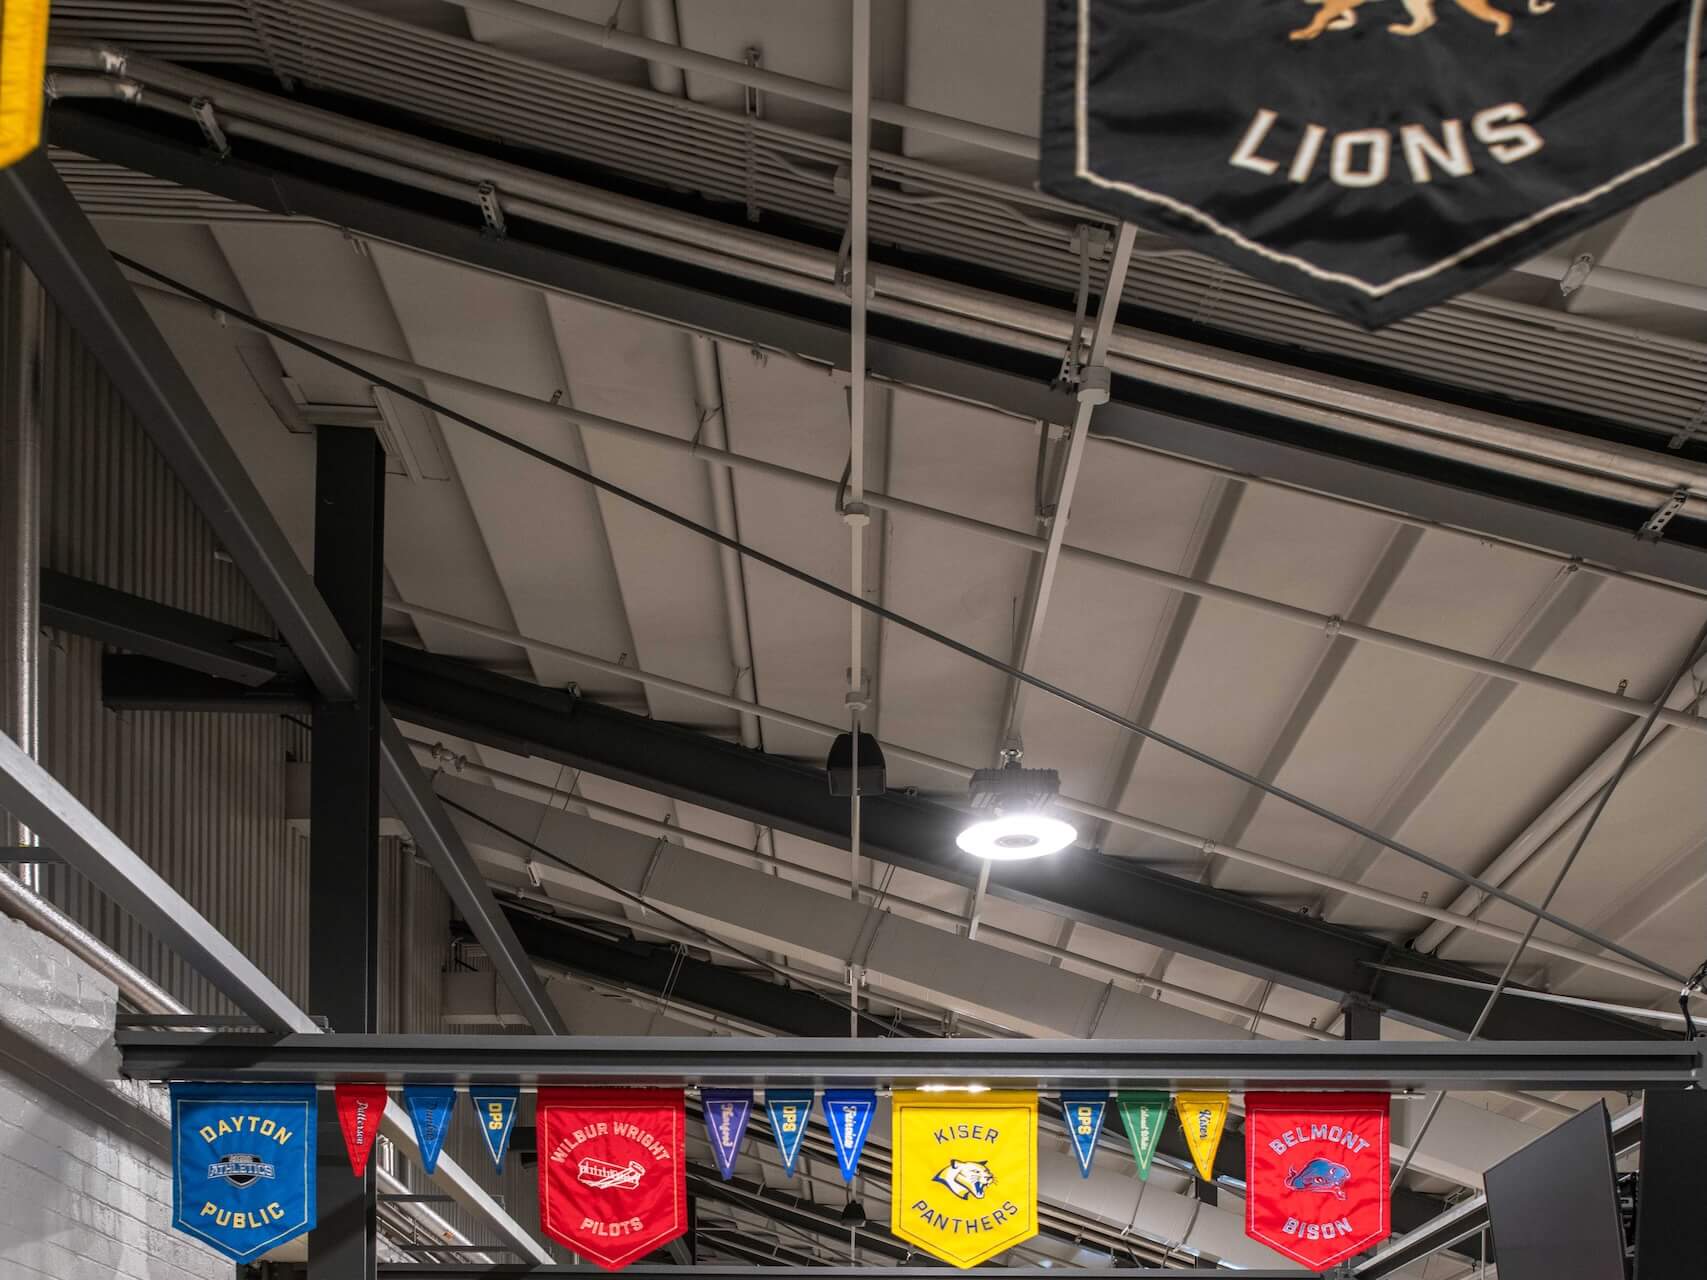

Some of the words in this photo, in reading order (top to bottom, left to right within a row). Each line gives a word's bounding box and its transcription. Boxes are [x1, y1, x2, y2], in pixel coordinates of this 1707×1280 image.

[1228, 101, 1546, 188] LIONS
[200, 1115, 293, 1145] DAYTON
[356, 1099, 369, 1145] Patterson
[488, 1103, 503, 1130] DPS
[783, 1106, 797, 1132] DPS
[842, 1106, 857, 1148] Fairview
[1078, 1106, 1092, 1135] DPS
[1199, 1109, 1212, 1139] Kiser
[550, 1122, 609, 1163] WILBUR
[613, 1121, 671, 1160] WRIGHT
[934, 1125, 999, 1144] KISER
[1268, 1124, 1370, 1155] BELMONT
[208, 1163, 275, 1177] ATHLETICS
[200, 1201, 285, 1228] PUBLIC
[580, 1217, 644, 1237] PILOTS
[912, 1200, 1018, 1234] PANTHERS
[1282, 1217, 1352, 1240] BISON
